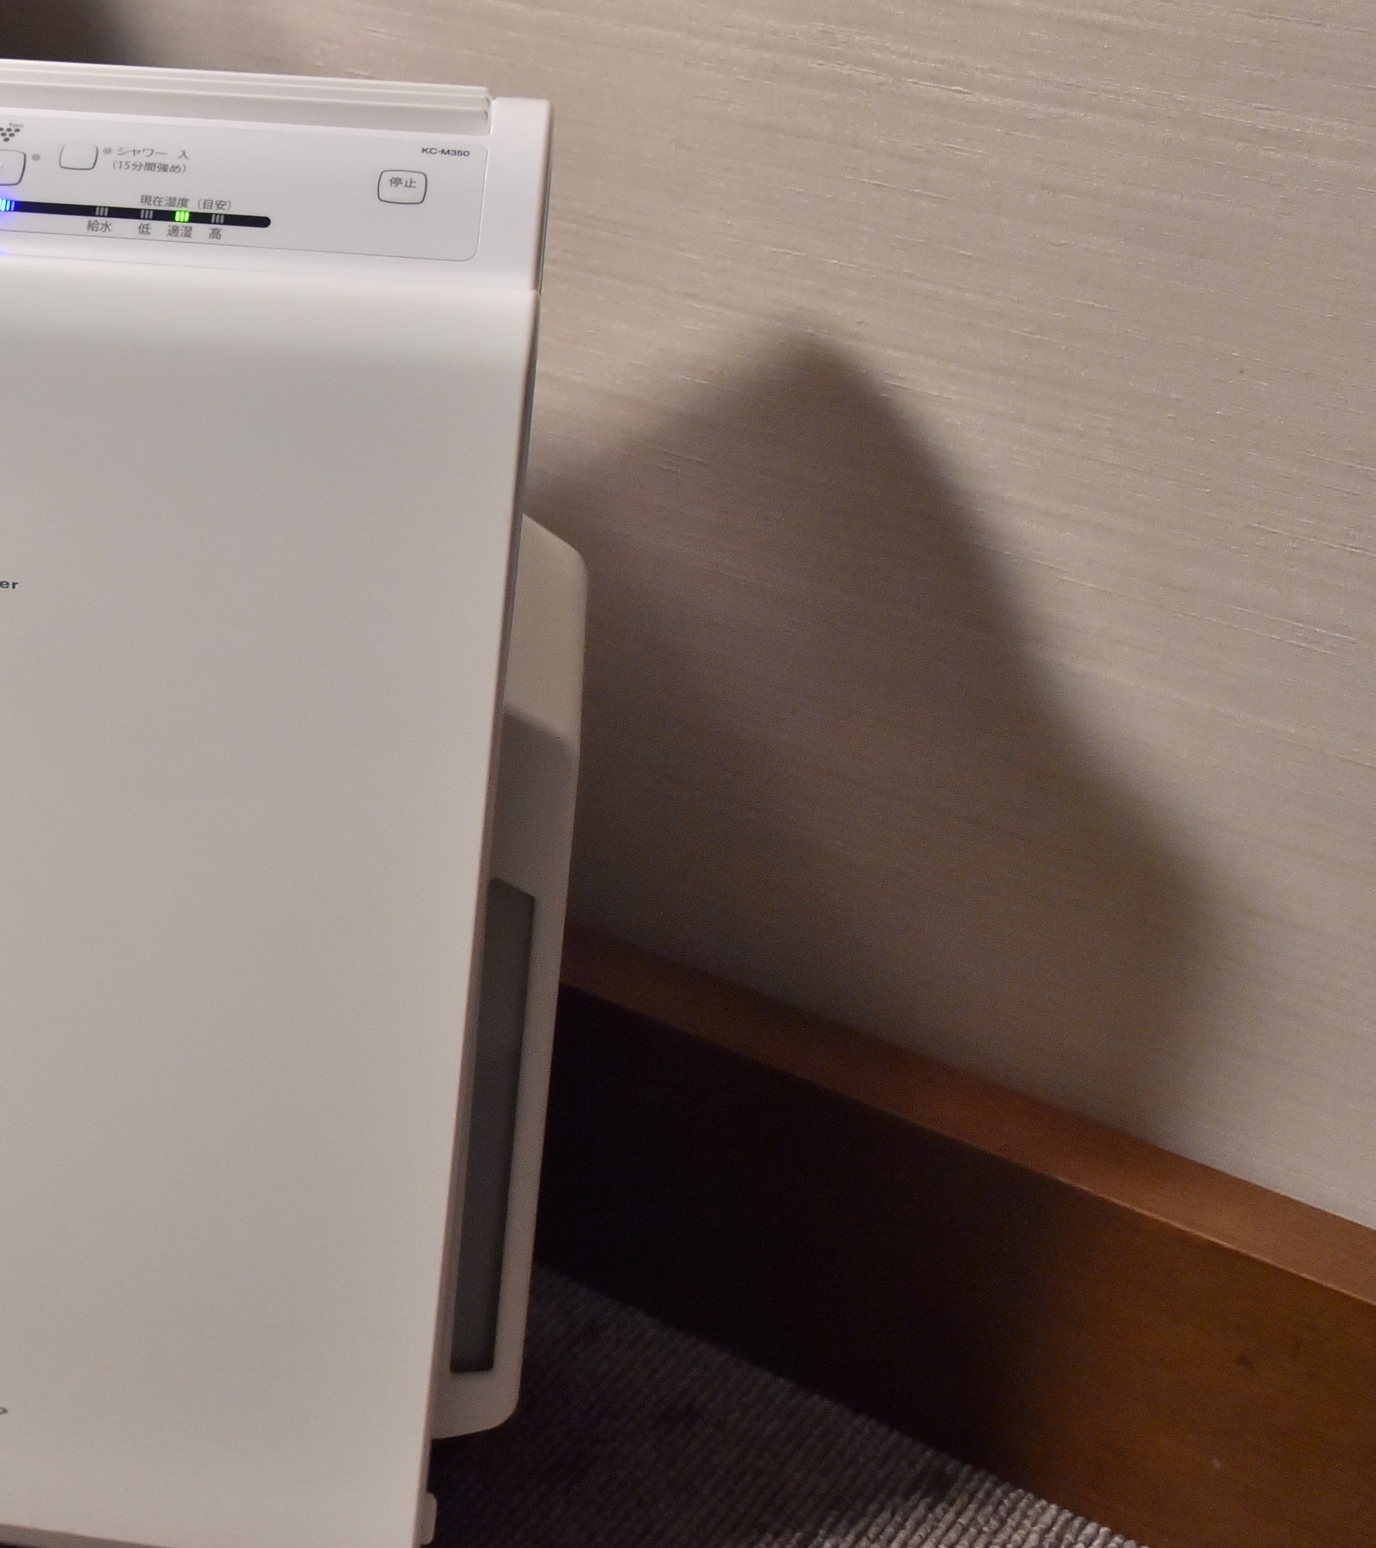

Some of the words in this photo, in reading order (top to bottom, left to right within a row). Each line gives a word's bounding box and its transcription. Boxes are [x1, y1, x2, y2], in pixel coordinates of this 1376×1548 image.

[117, 146, 168, 158] シャワー
[178, 150, 189, 160] 入
[421, 147, 470, 157] KC-M350
[389, 176, 417, 189] 停止
[86, 219, 113, 233] 給水
[138, 222, 152, 235] 低
[166, 224, 193, 238] 適湿
[208, 227, 223, 240] 高
